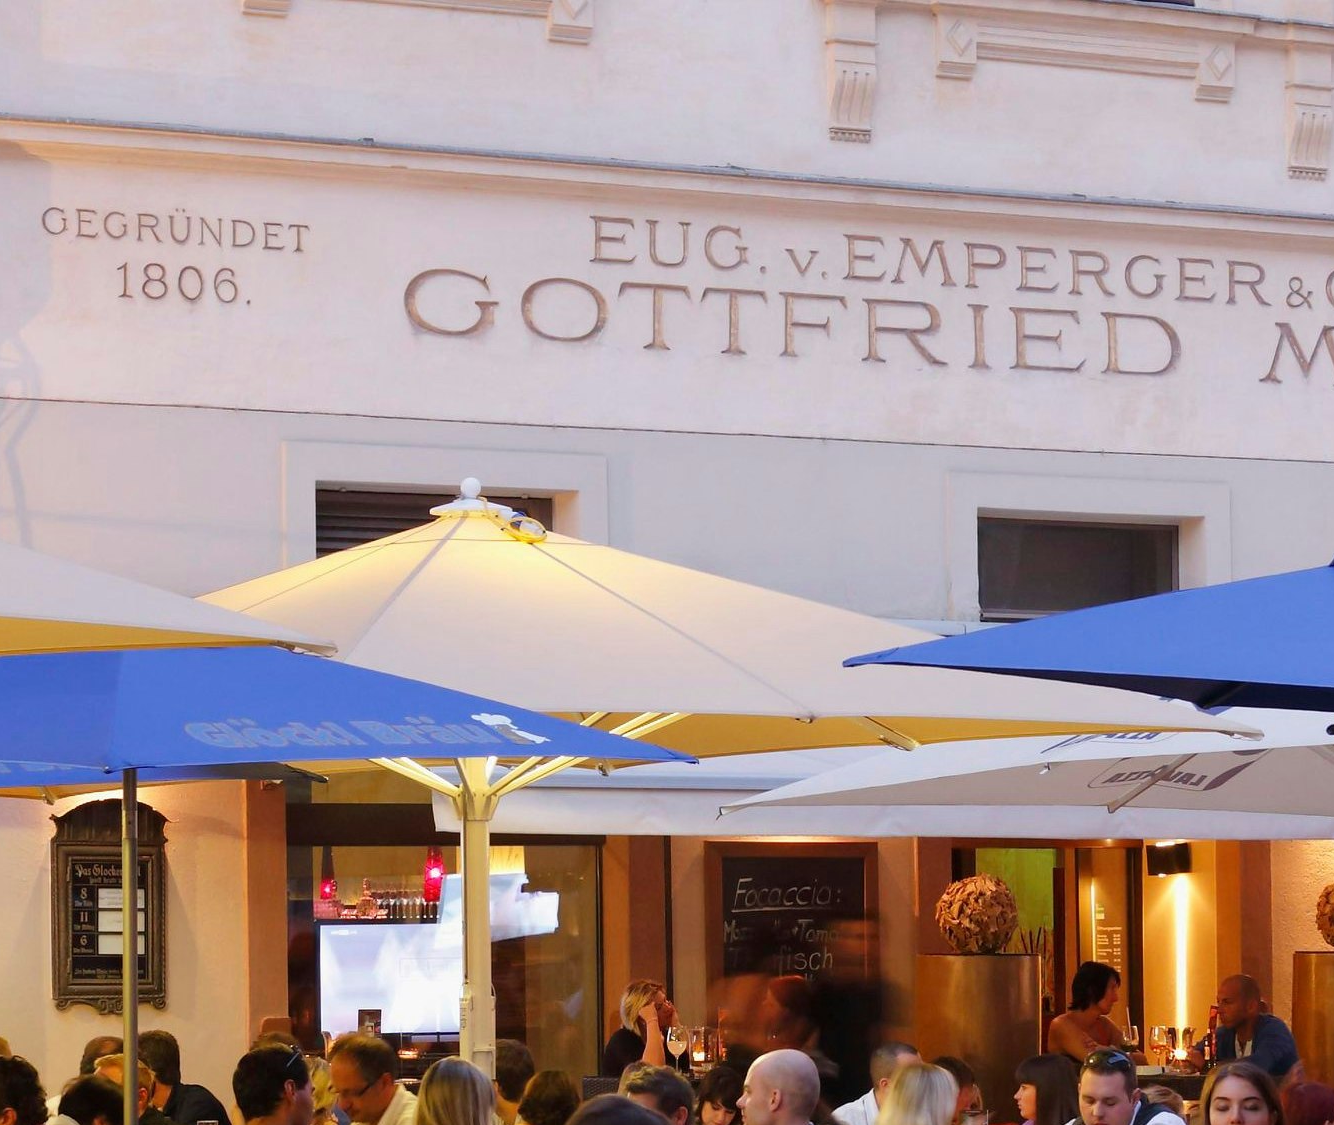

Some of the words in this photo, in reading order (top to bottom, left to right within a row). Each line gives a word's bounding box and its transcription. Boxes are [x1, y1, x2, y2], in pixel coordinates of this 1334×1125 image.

[41, 205, 312, 254] GEGRÜNDET
[116, 261, 252, 306] 1806.
[590, 215, 767, 274] EUG.
[841, 233, 1272, 308] EMPERGER
[1285, 276, 1314, 311] &
[403, 268, 1181, 375] GOTTFRIED
[184, 718, 367, 749] Glöckl
[349, 715, 501, 745] Bräu
[80, 887, 88, 900] 8
[80, 935, 88, 946] 6
